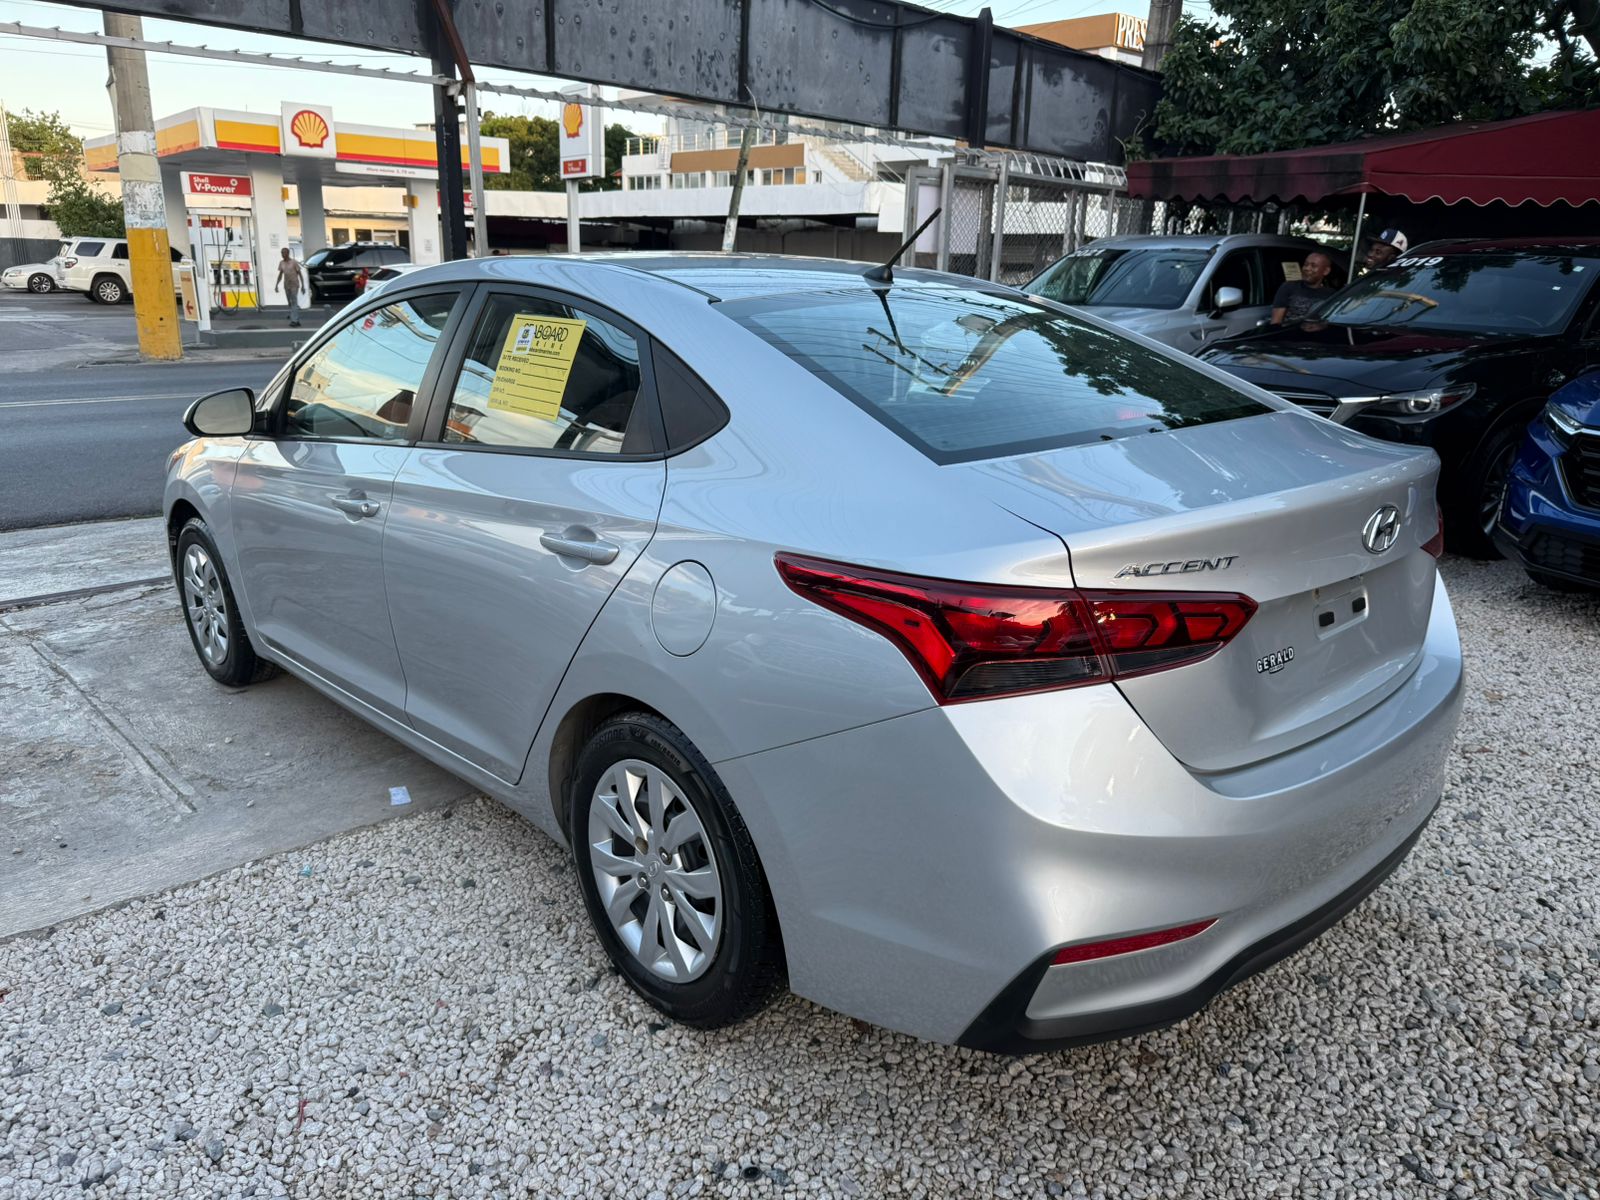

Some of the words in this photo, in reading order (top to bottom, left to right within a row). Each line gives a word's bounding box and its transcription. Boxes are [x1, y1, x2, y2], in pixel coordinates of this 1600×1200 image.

[192, 175, 209, 183] Shell
[194, 182, 236, 193] V-Power
[1386, 256, 1444, 268] 2019
[1115, 555, 1240, 578] ACCENT
[1256, 647, 1294, 673] GERALD
